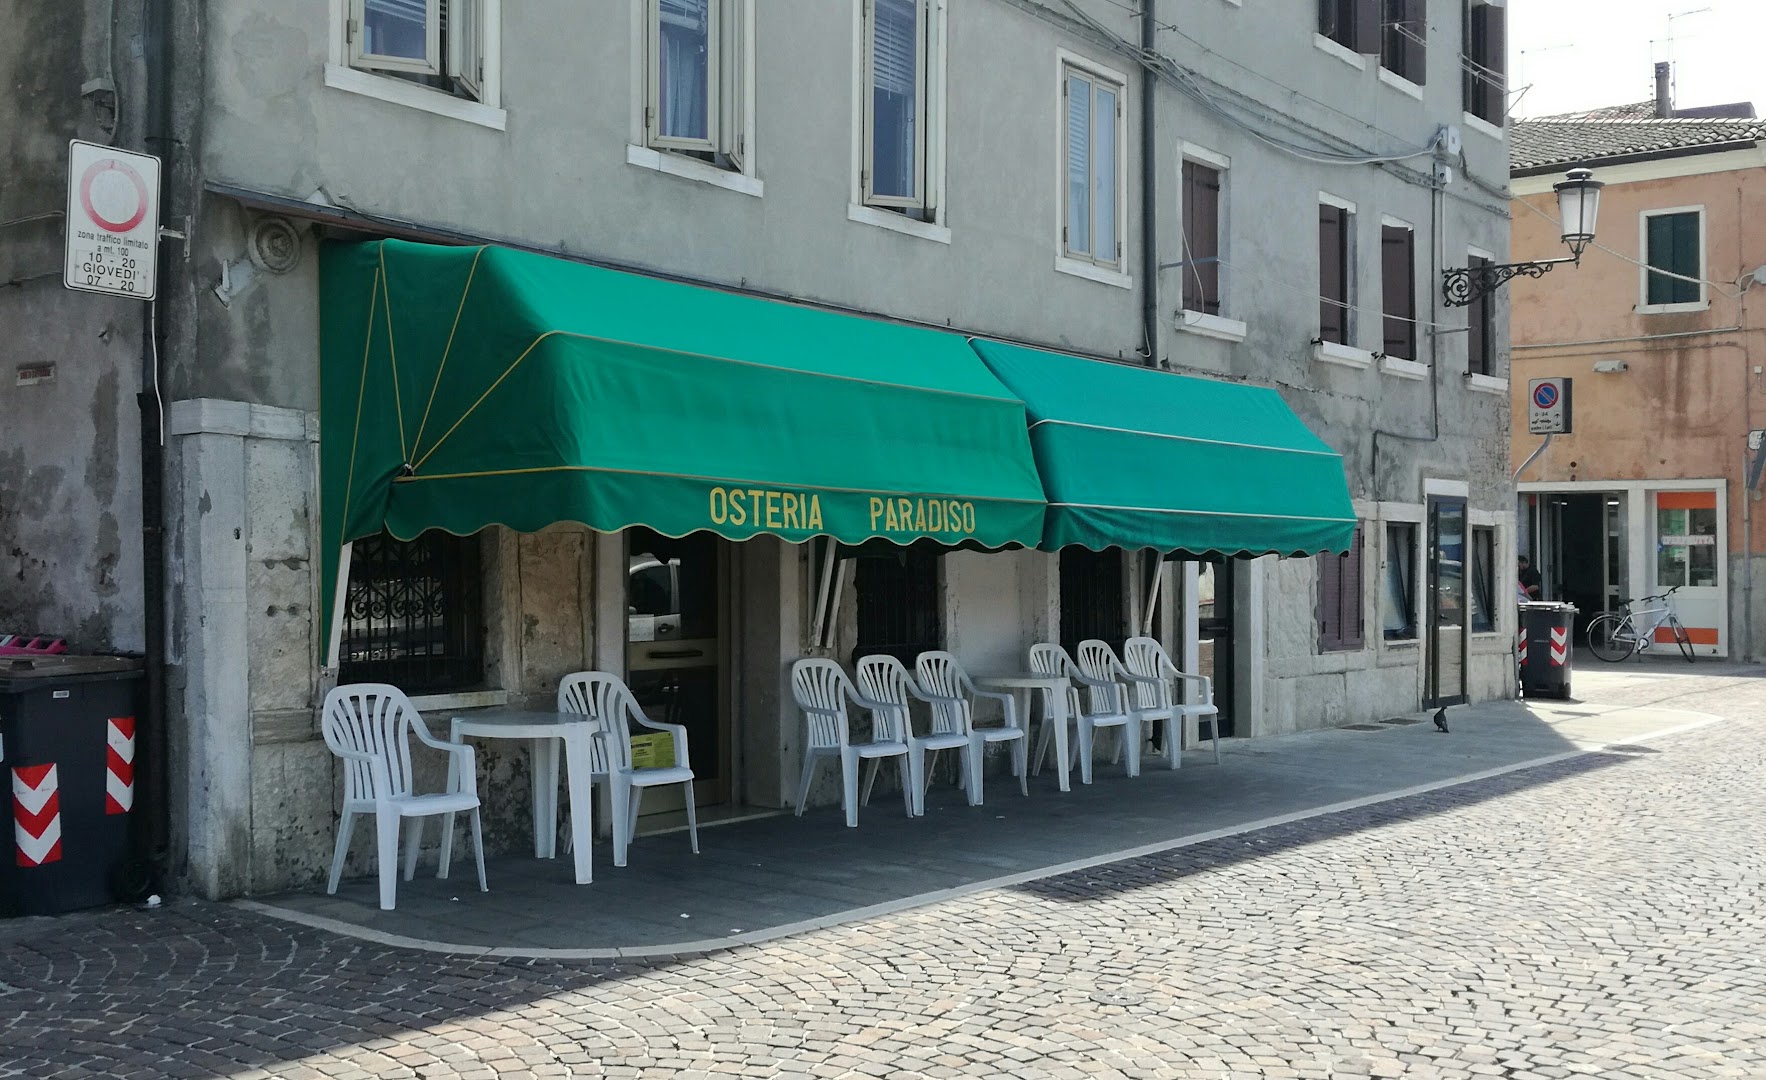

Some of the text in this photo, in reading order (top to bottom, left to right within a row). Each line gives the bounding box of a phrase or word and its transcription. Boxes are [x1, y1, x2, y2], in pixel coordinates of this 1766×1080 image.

[77, 230, 148, 249] zona traffico limitato
[104, 245, 114, 254] mt.
[117, 247, 129, 256] 100
[89, 252, 103, 263] 10
[122, 257, 136, 269] 20
[87, 274, 101, 286] 07
[120, 280, 134, 292] 20
[709, 486, 976, 534] OSTERIA PARADISO
